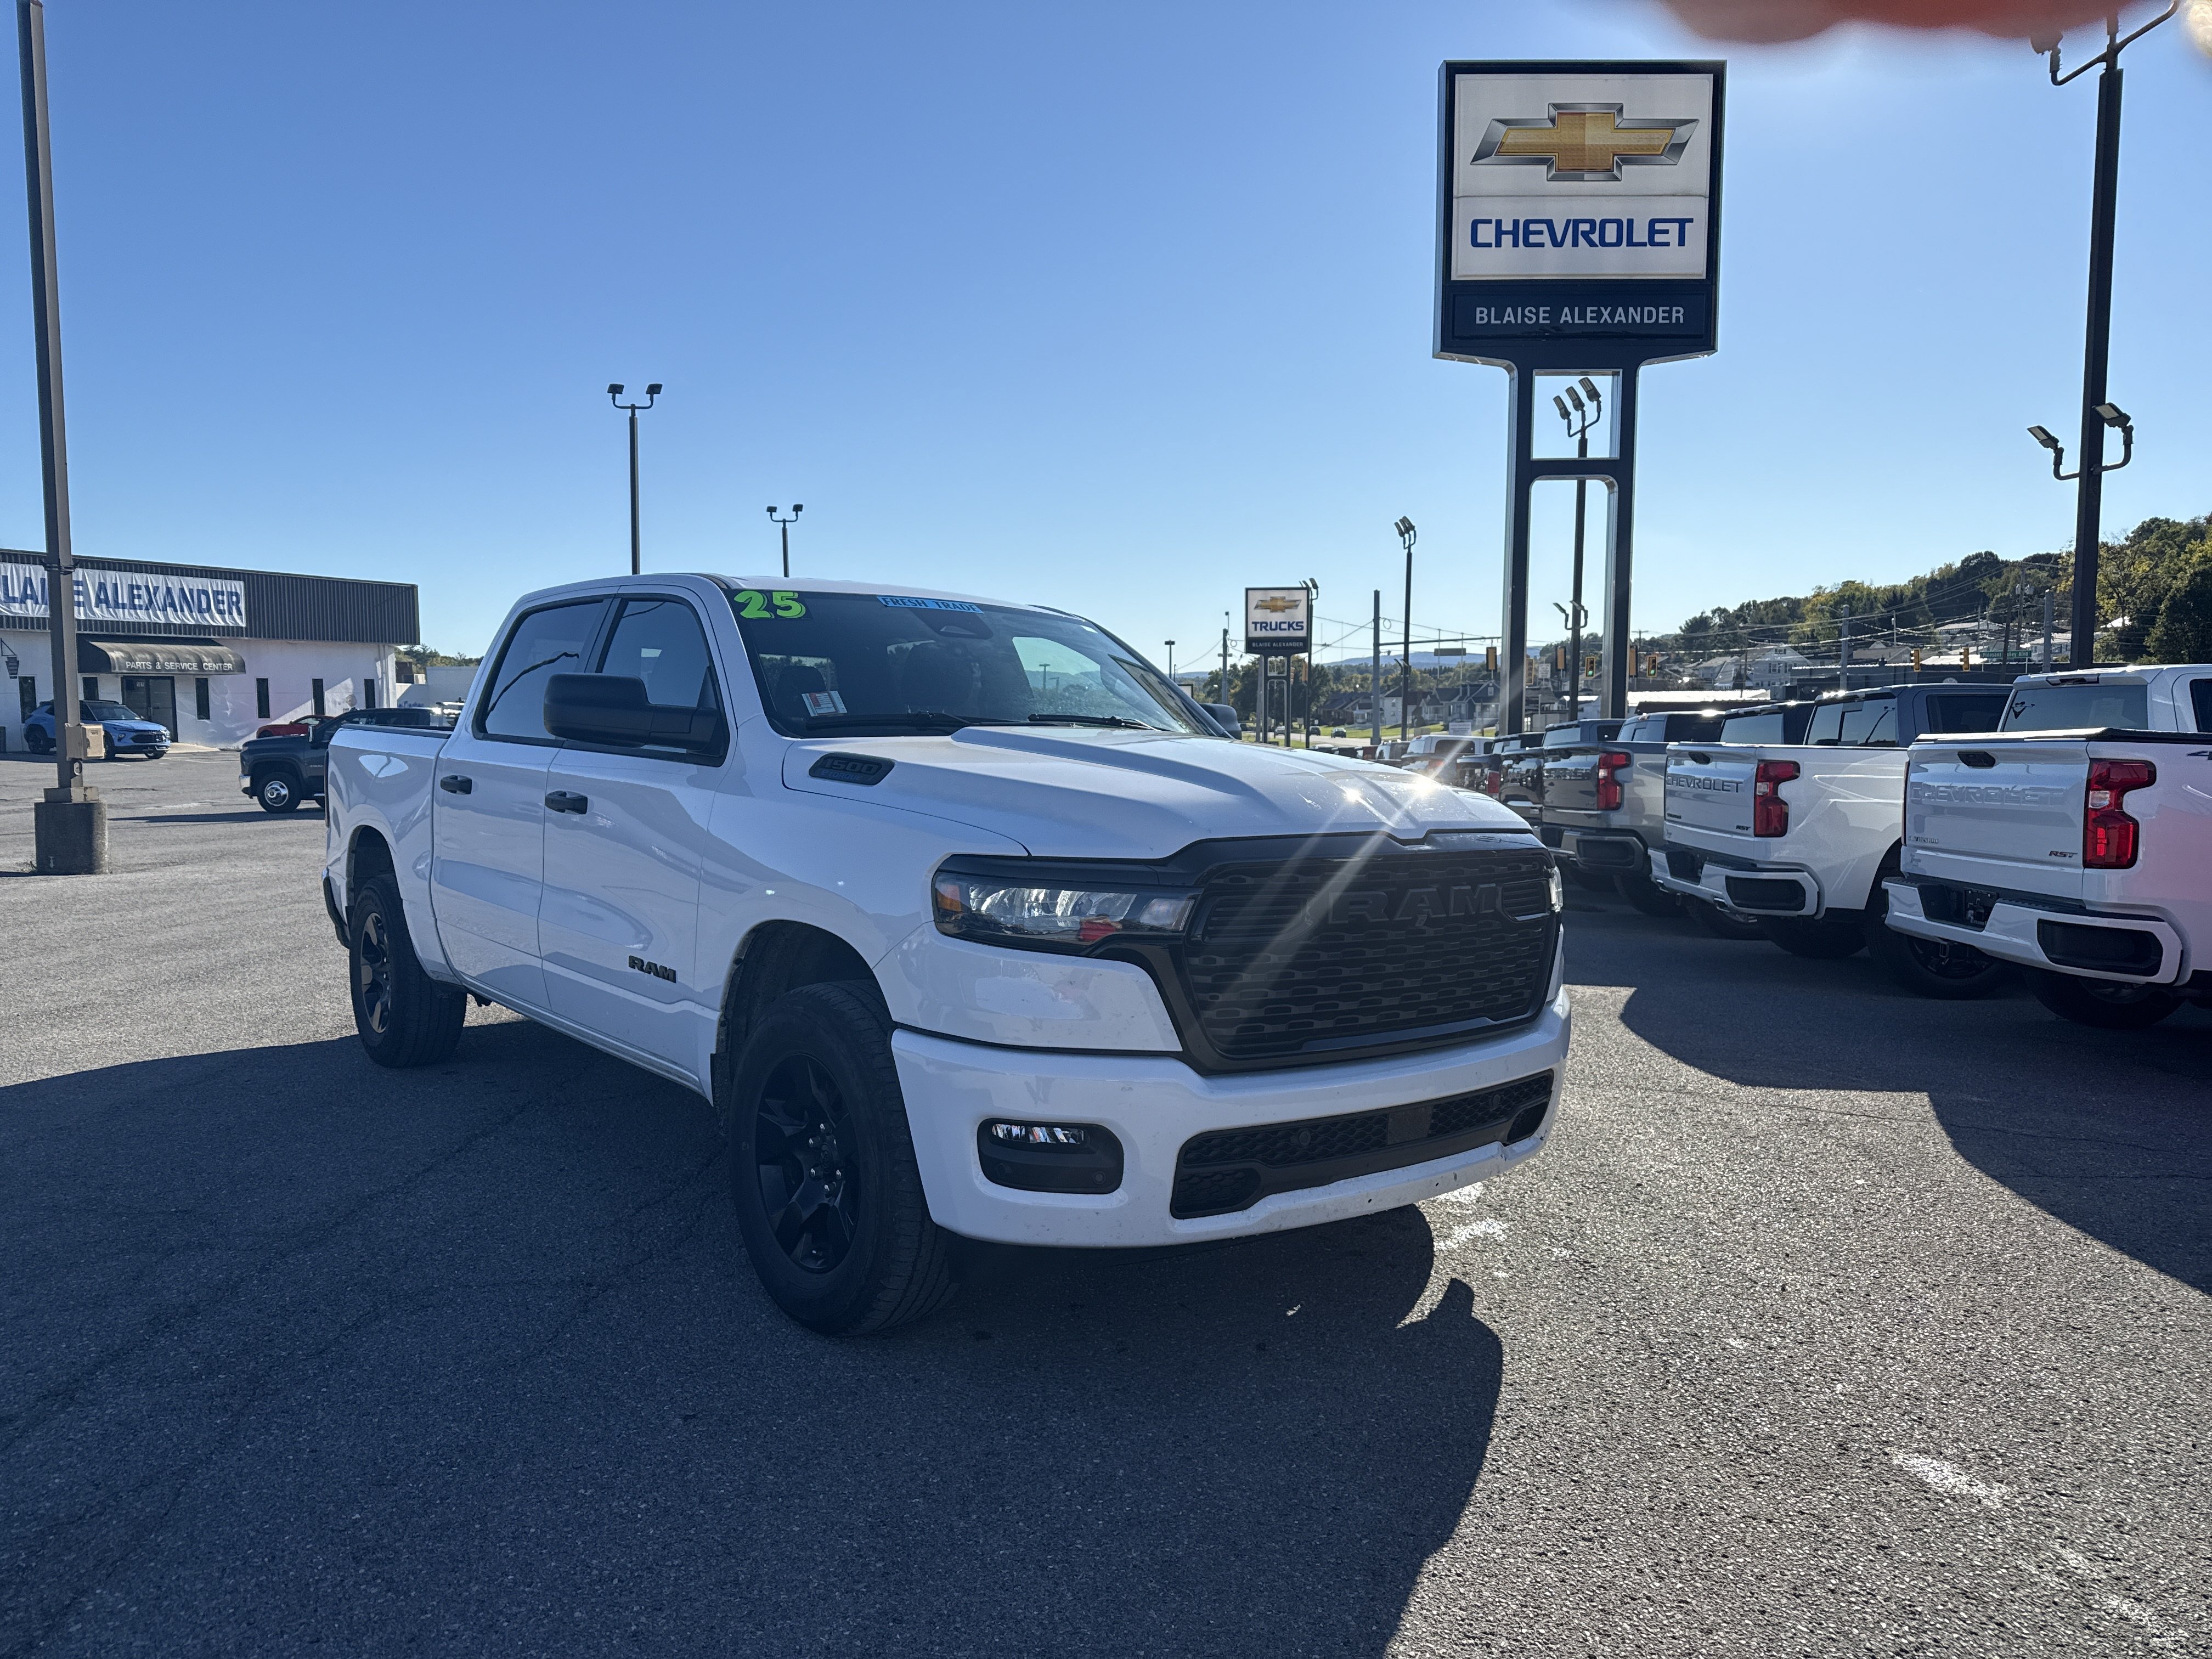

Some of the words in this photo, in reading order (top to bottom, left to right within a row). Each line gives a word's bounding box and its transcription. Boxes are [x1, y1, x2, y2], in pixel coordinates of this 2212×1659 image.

[1470, 217, 1694, 248] CHEVROLET
[1475, 307, 1551, 325] BLAISE
[1559, 306, 1684, 324] ALEXANDER
[2, 574, 84, 607] LAIE
[94, 582, 243, 616] ALEXANDER
[733, 590, 806, 619] 25
[881, 597, 928, 607] FRESH
[933, 601, 980, 612] TRADE
[1251, 620, 1304, 631] TRUCKS
[165, 662, 198, 670] SERVICE
[825, 759, 878, 774] 1500
[1666, 776, 1743, 793] CHEVROLET
[1328, 883, 1497, 924] RAM
[628, 955, 676, 984] RAM
